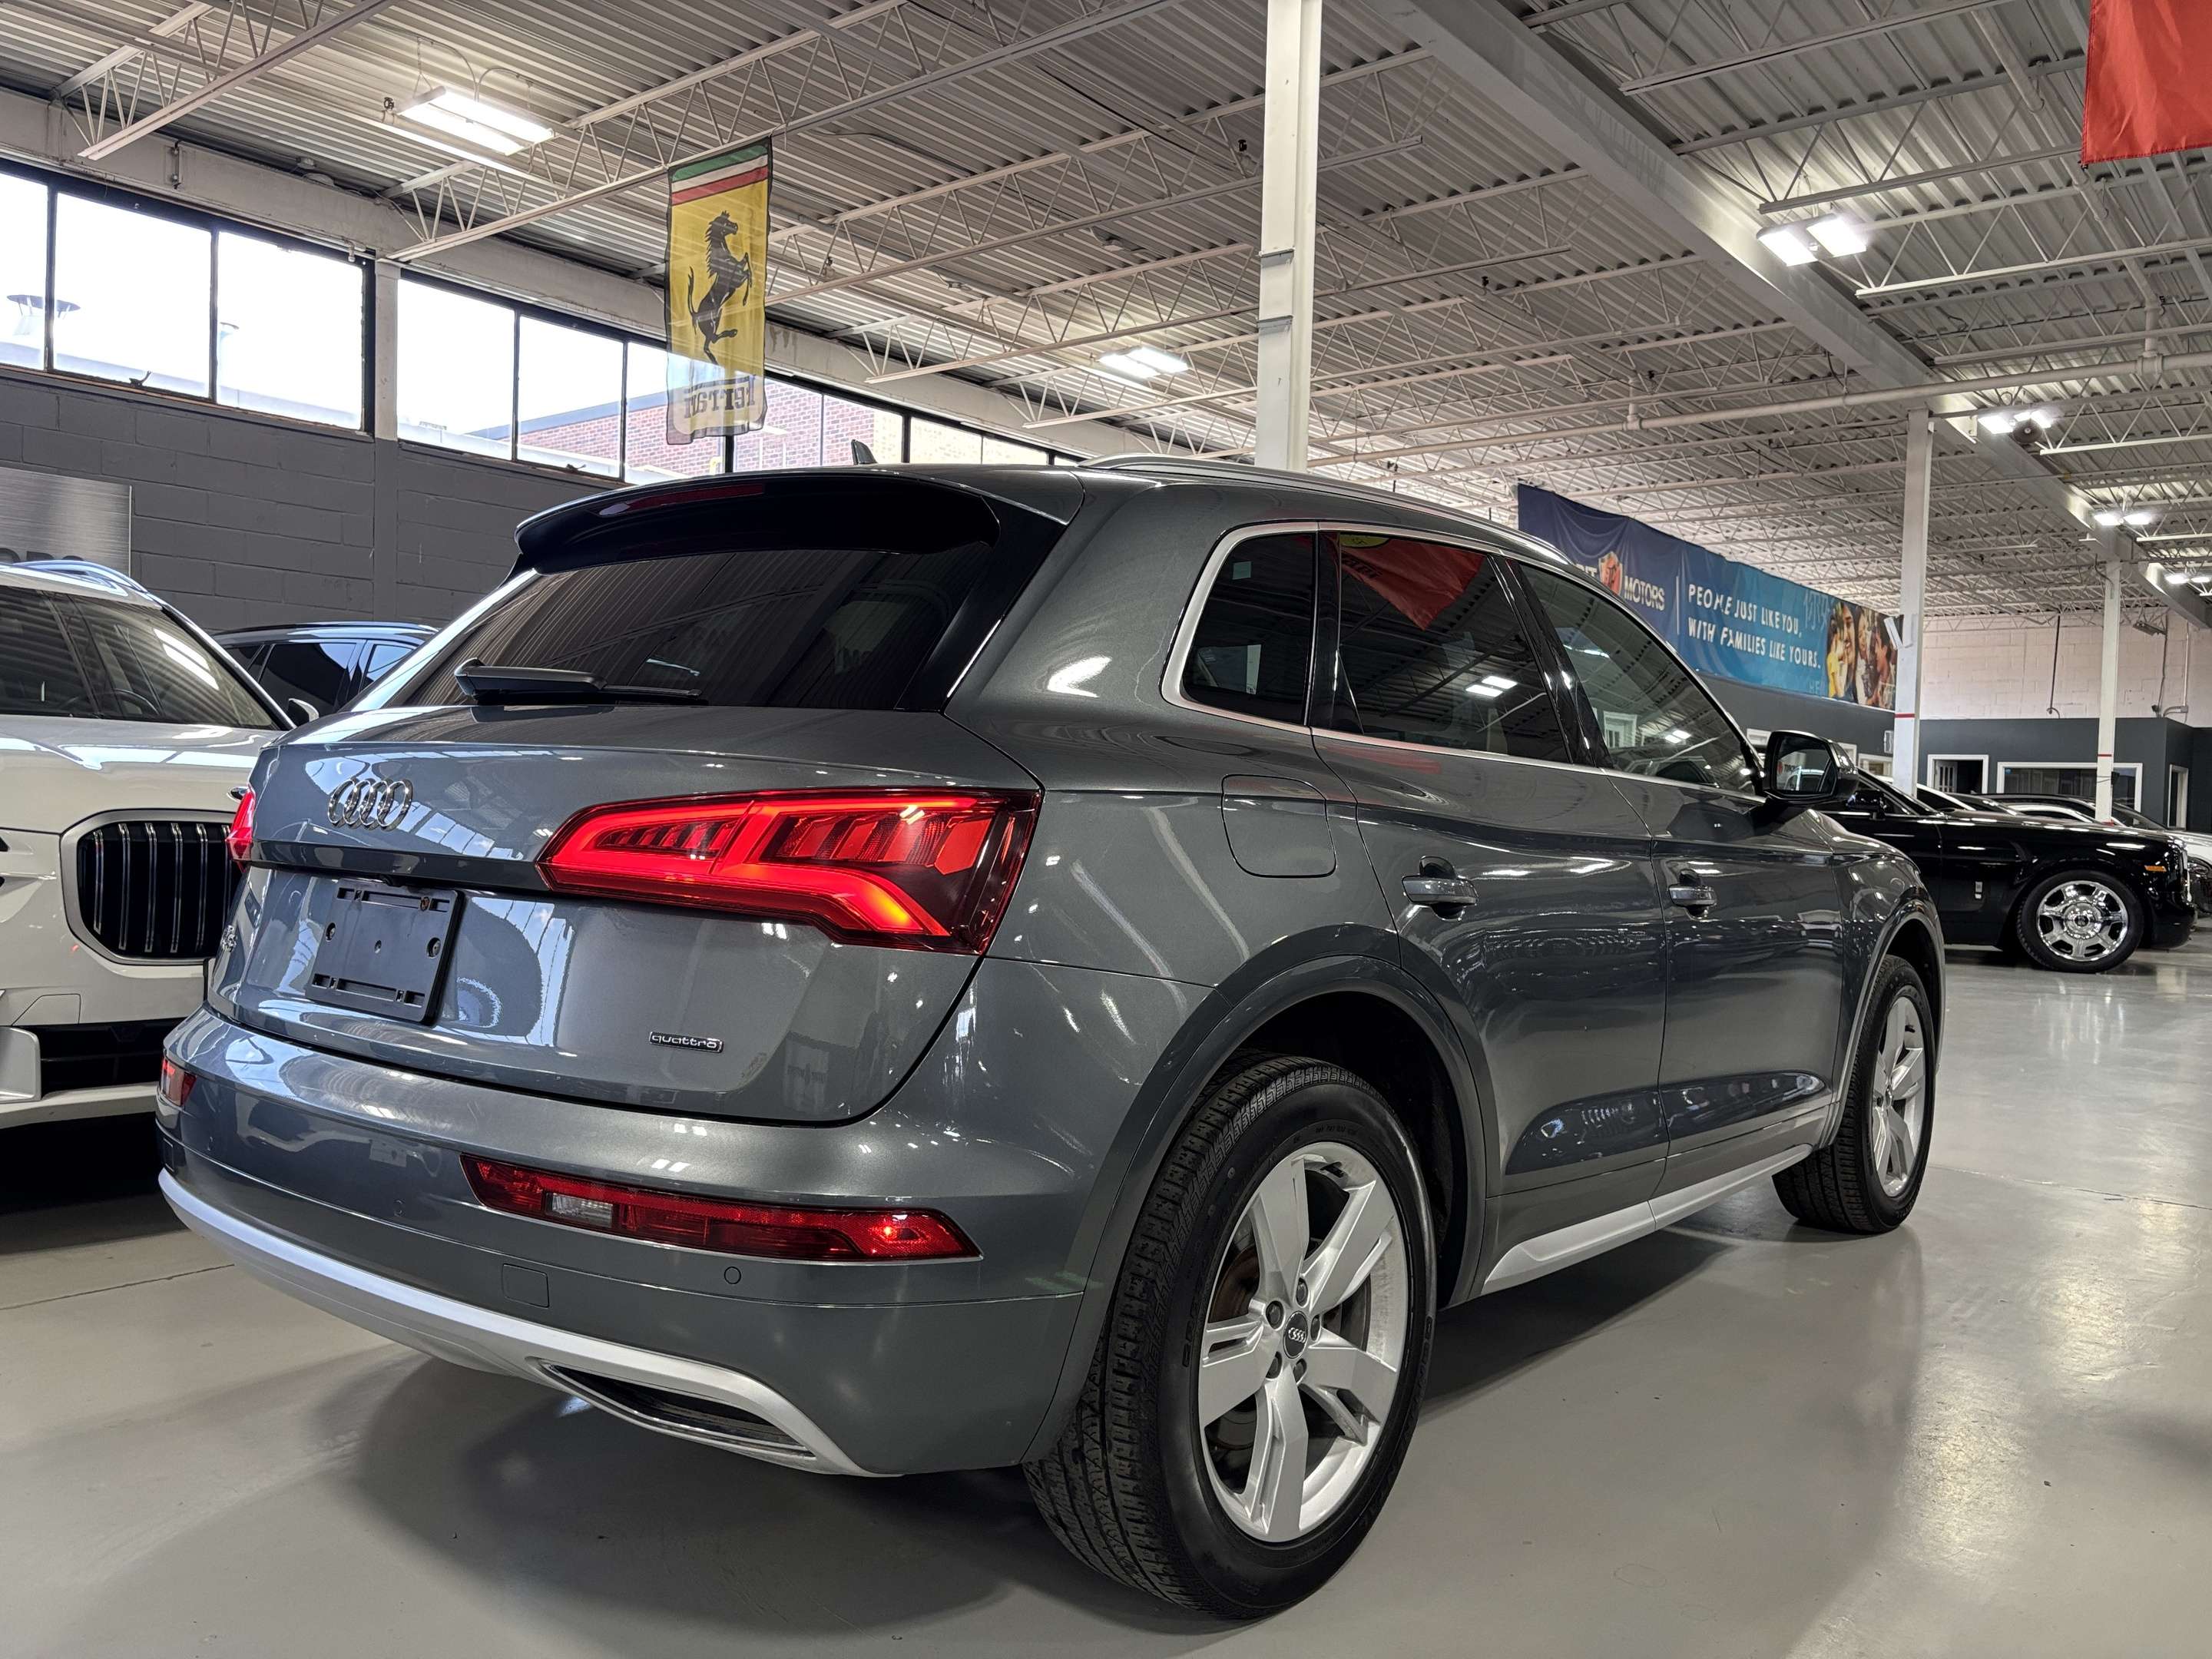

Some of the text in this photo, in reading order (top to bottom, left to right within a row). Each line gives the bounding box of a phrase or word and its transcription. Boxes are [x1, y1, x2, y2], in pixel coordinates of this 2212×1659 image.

[1624, 575, 1664, 611] MOTORS
[1734, 599, 1757, 622] JUST
[1761, 607, 1780, 629] LIKE
[1782, 613, 1802, 638] YOU,
[1688, 617, 1821, 669] WITH FAMILIES LIKE YOURS.
[651, 1035, 717, 1048] quattro
